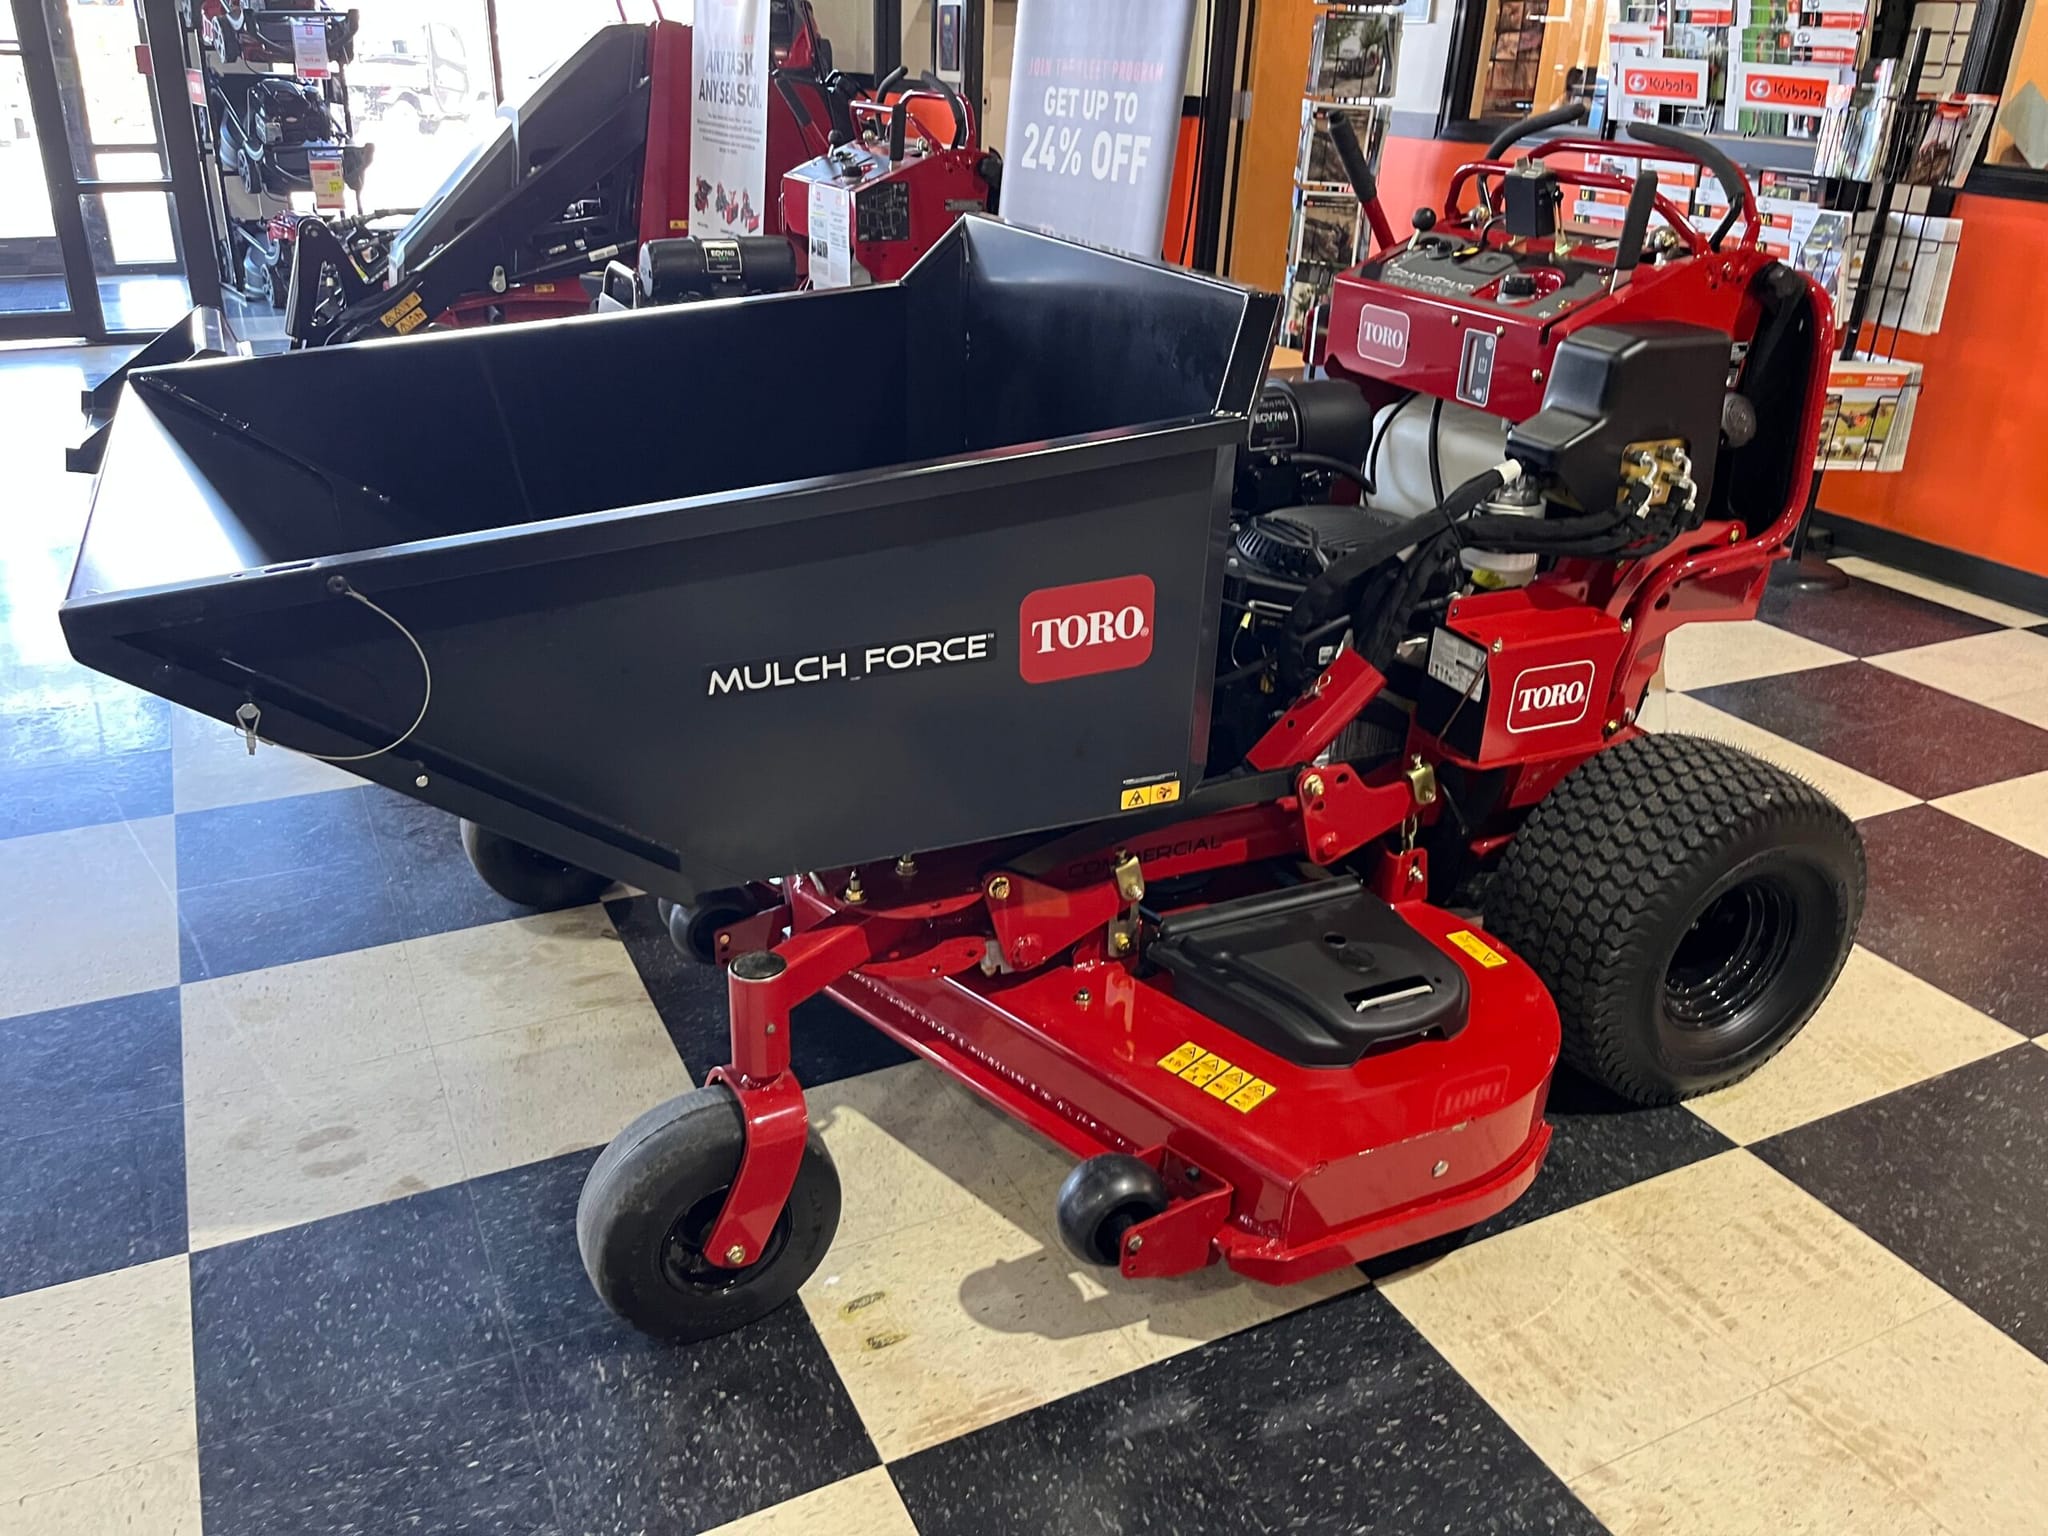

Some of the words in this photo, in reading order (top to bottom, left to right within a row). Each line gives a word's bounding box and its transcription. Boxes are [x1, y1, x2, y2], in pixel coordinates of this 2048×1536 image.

[699, 78, 719, 102] ANY
[1649, 76, 1692, 94] Kubota
[1773, 83, 1823, 102] Kubota
[1044, 86, 1080, 119] GET
[1082, 89, 1109, 121] UP
[1114, 91, 1138, 125] TO
[1021, 122, 1082, 176] 24%
[1091, 130, 1152, 184] OFF
[1363, 320, 1404, 351] TORO
[708, 653, 848, 696] MULCH
[1518, 680, 1585, 713] TORO
[1068, 836, 1223, 880] COERCIAL
